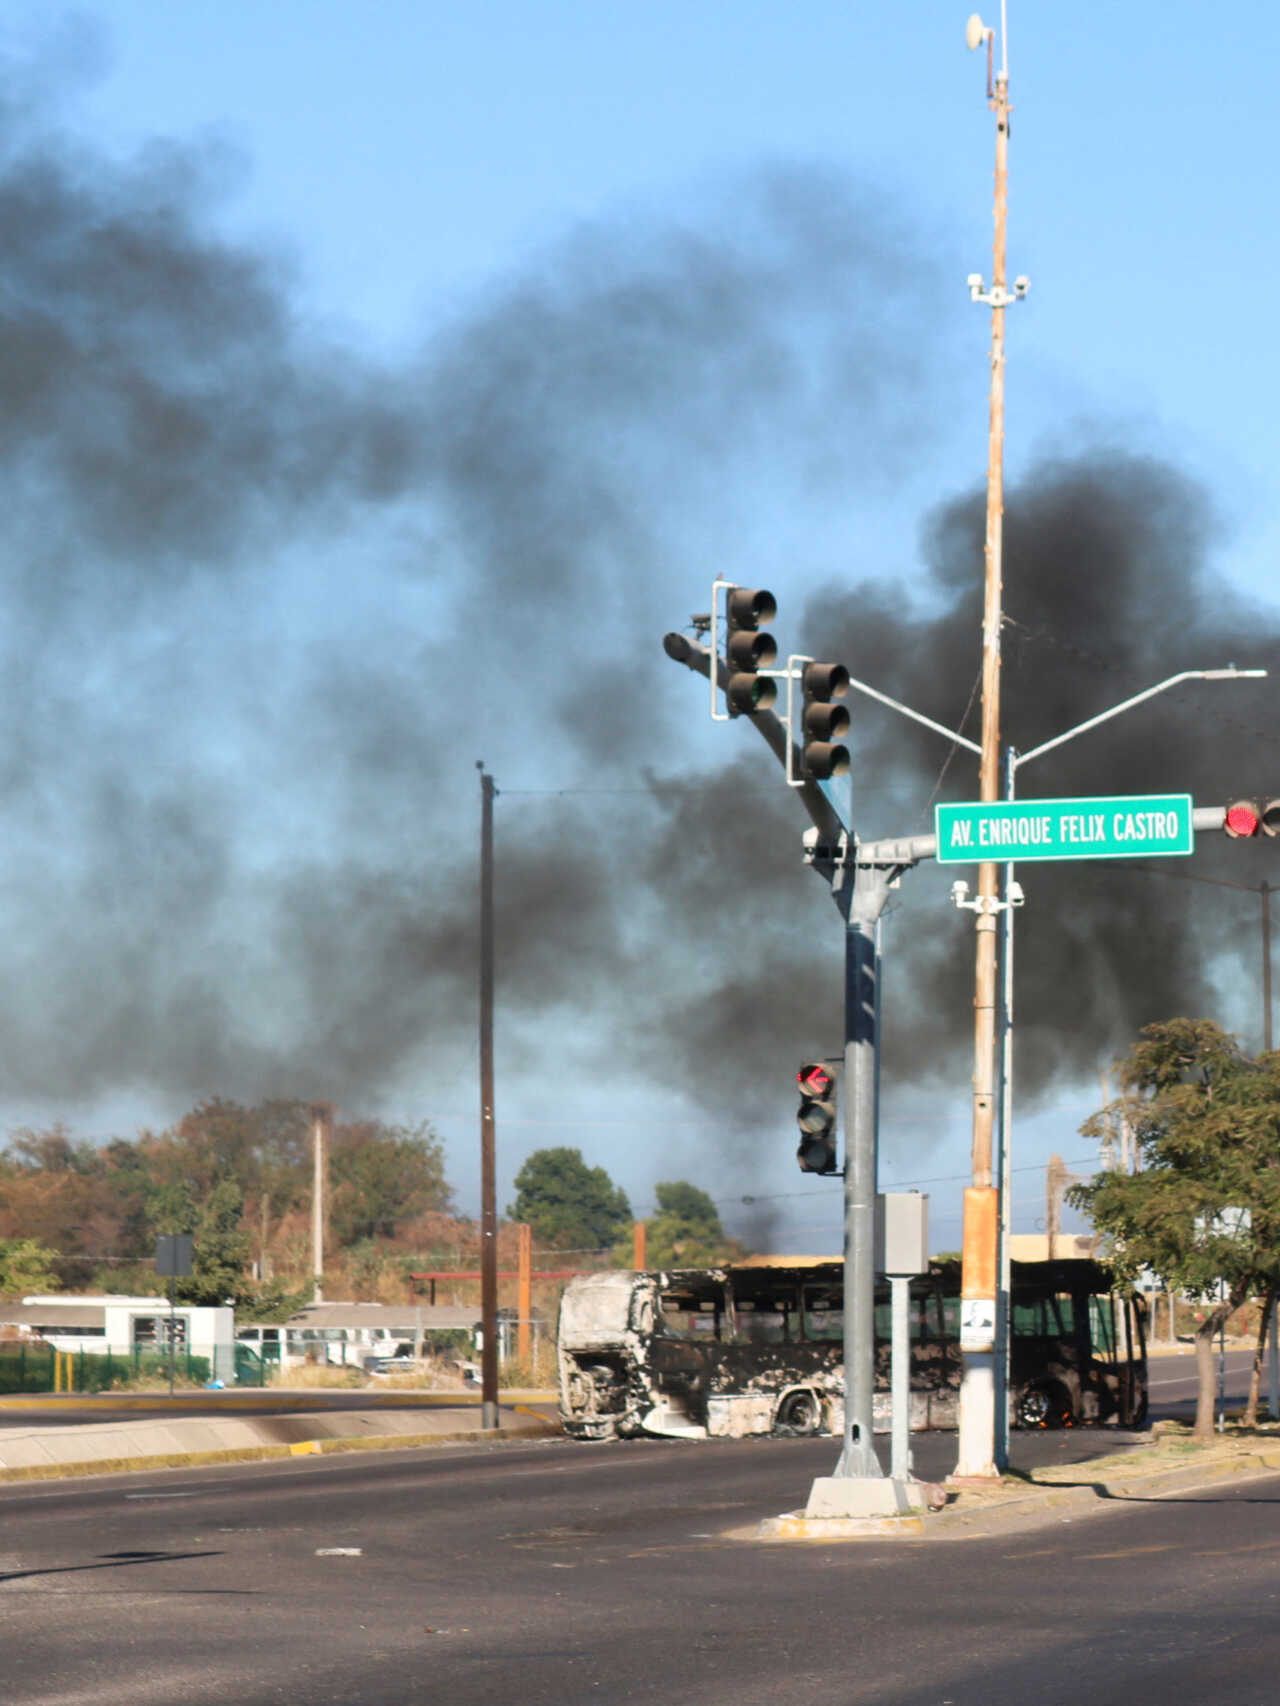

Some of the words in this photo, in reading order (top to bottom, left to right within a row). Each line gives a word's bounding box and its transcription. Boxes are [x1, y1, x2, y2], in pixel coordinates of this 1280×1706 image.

[951, 819, 974, 846] AV.
[979, 816, 1052, 846] ENRIQUE
[1060, 814, 1106, 843] FELIX
[1113, 811, 1179, 841] CASTRO
